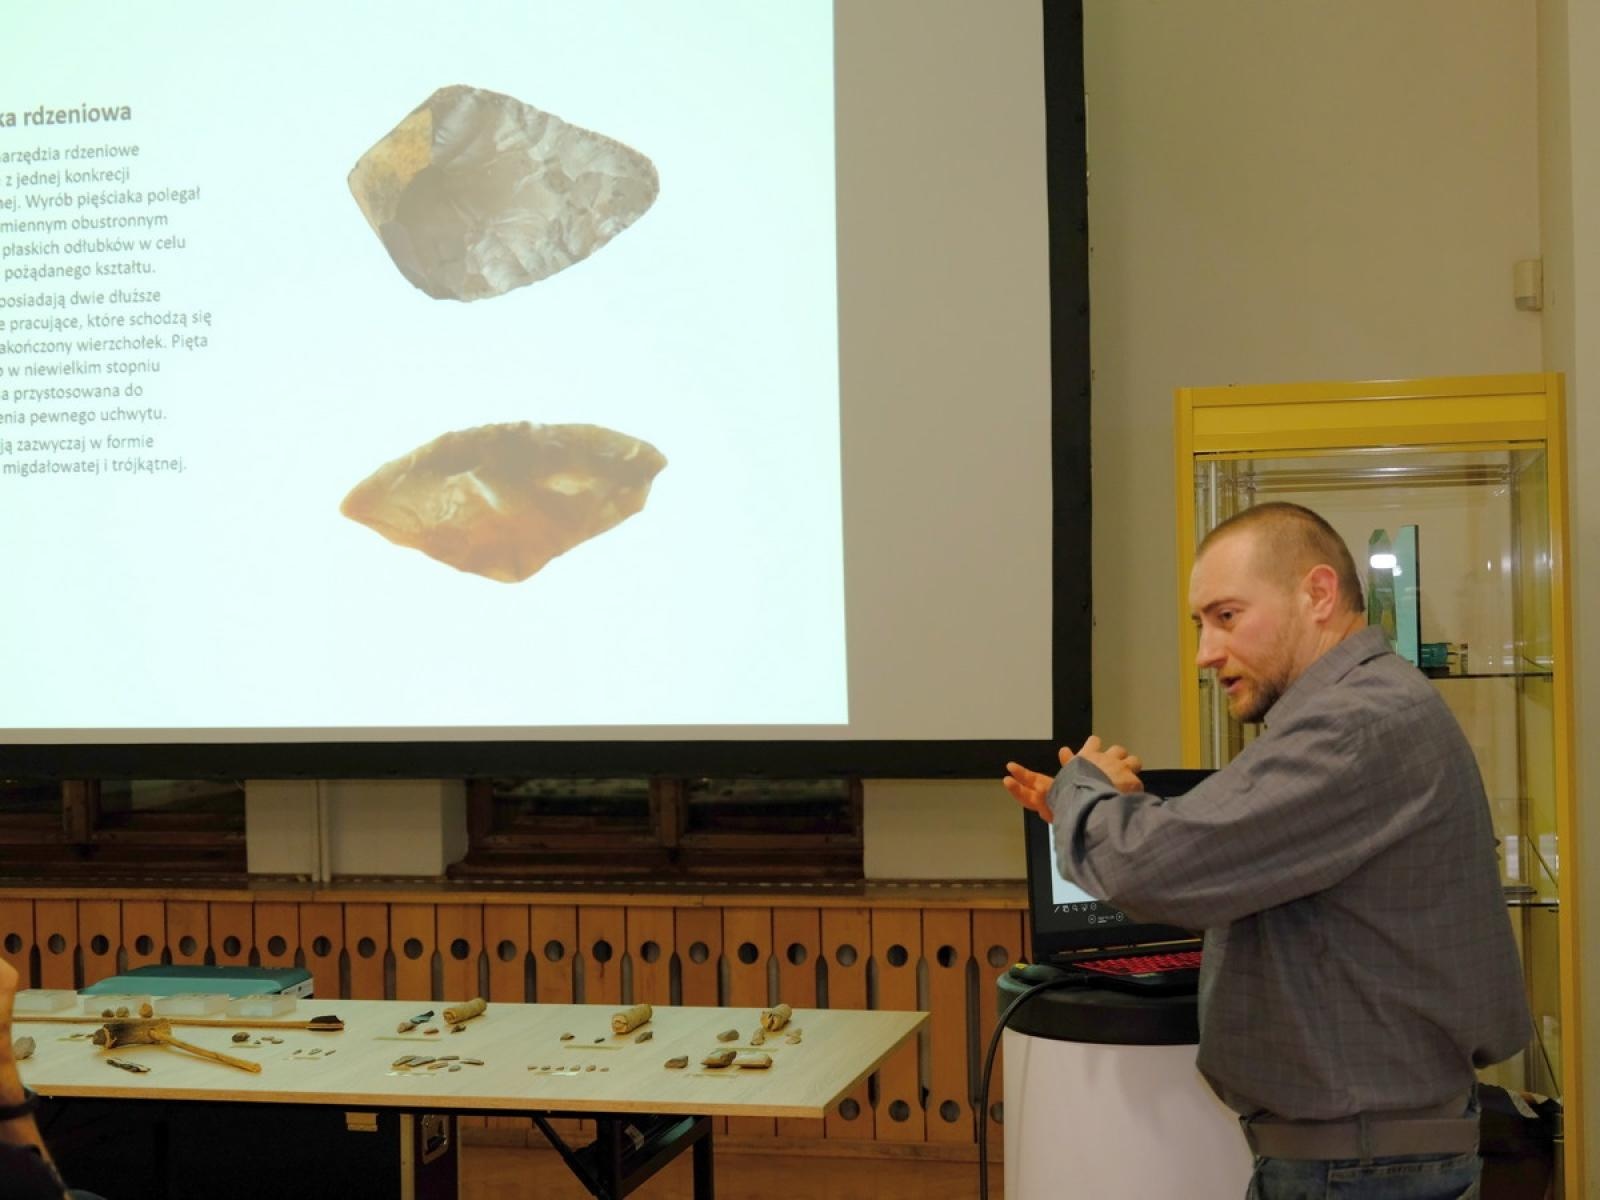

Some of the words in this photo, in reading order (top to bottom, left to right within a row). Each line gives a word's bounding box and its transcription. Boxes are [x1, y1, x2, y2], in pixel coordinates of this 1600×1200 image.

[23, 103, 132, 126] rdzeniowa
[0, 147, 60, 165] arzędzia
[65, 144, 140, 160] rdzeniowe
[5, 174, 12, 186] z
[16, 170, 60, 189] jednej
[65, 167, 130, 184] konkrecji
[26, 192, 72, 210] Wyrób
[78, 188, 143, 208] pięściaka
[147, 187, 200, 205] polegał
[72, 214, 168, 230] obustronnym
[3, 241, 59, 259] płaskich
[64, 238, 134, 254] odłubków
[140, 239, 151, 250] w
[156, 235, 185, 250] celu
[4, 263, 91, 282] pożądanego
[95, 260, 155, 276] kształtu.
[70, 291, 104, 306] dwie
[109, 289, 160, 304] dłuższe
[10, 315, 82, 333] pracujące,
[88, 313, 124, 327] które
[129, 311, 187, 326] schodzą
[192, 310, 212, 326] się
[77, 335, 166, 351] wierzchołek.
[172, 334, 208, 350] Pięta
[9, 364, 19, 376] w
[25, 361, 101, 376] niewielkim
[106, 359, 160, 375] stopniu
[14, 386, 120, 403] przystosowana
[125, 383, 143, 397] do
[30, 410, 95, 425] pewnego
[101, 407, 167, 423] uchwytu.
[17, 436, 85, 452] zazwyczaj
[90, 438, 102, 449] w
[107, 435, 154, 449] formie
[4, 459, 99, 477] migdałowatej
[104, 458, 107, 471] i
[112, 456, 187, 474] trójkątnej.
